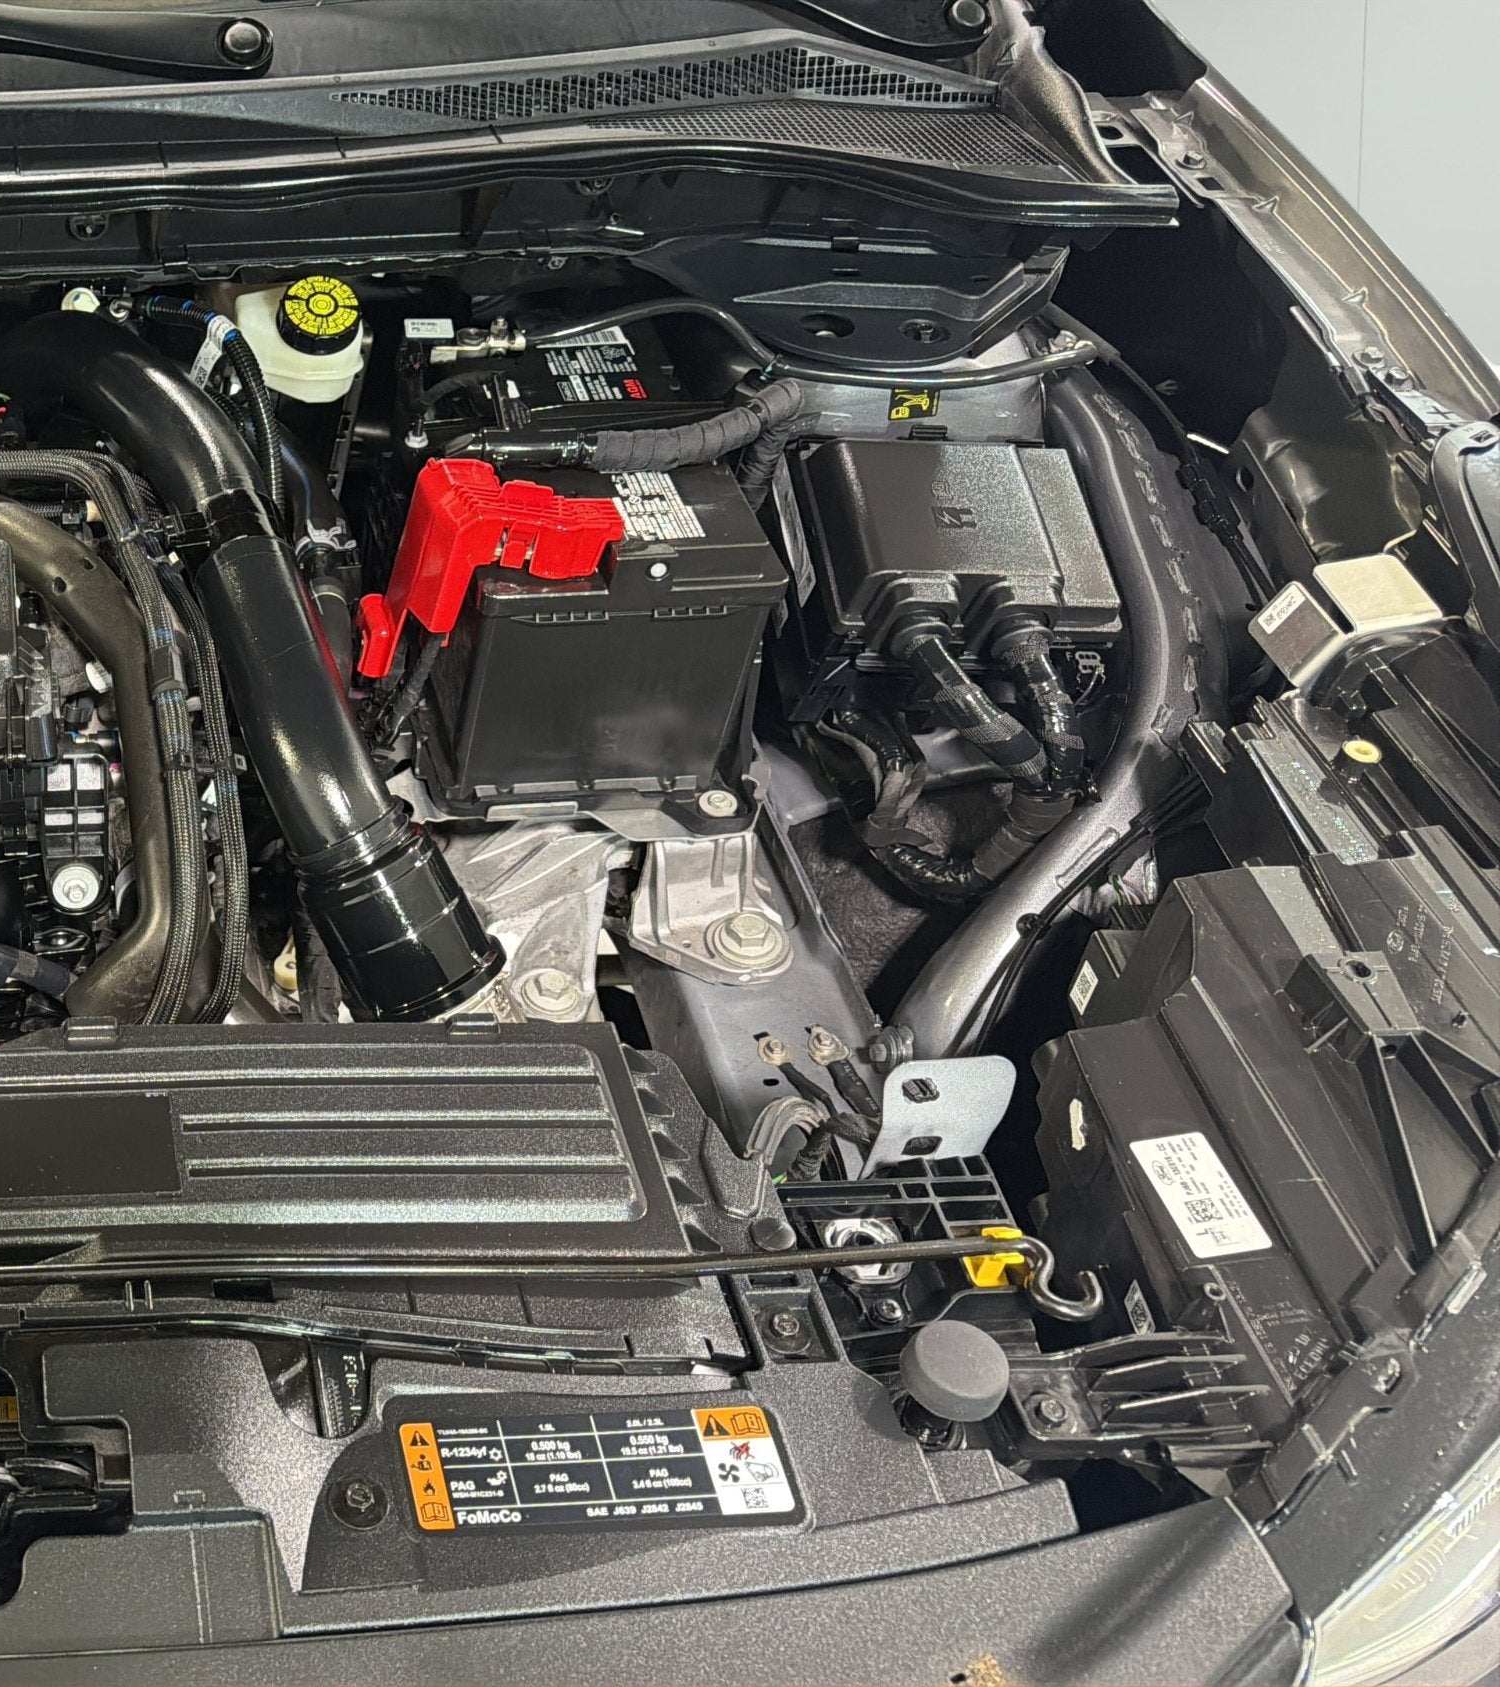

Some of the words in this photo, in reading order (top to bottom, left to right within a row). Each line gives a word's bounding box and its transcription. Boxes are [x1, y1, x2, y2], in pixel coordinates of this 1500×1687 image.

[623, 379, 642, 398] AGM
[1196, 1228, 1210, 1236] L
[538, 1423, 556, 1432] 1.5L
[531, 1440, 556, 1451] 0.500
[556, 1440, 570, 1452] kg
[630, 1436, 654, 1446] 0.550
[655, 1434, 669, 1446] kg
[440, 1446, 487, 1458] R-1234yf
[525, 1452, 536, 1461] 18
[566, 1450, 582, 1460] lbs)
[620, 1447, 638, 1456] 19.5
[649, 1446, 667, 1456] (1.21
[668, 1444, 684, 1454] lbs)
[550, 1474, 569, 1482] PAG
[650, 1468, 668, 1478] PAG
[450, 1480, 476, 1491] PAG
[534, 1485, 546, 1494] 2.7
[547, 1484, 554, 1492] fl
[566, 1483, 590, 1494] (80cc)
[632, 1480, 644, 1490] 3.4
[644, 1480, 652, 1488] fl
[663, 1478, 692, 1489] (100cc)
[586, 1508, 609, 1516] SAE
[613, 1506, 637, 1516] J639
[641, 1504, 670, 1514] J2842
[674, 1502, 704, 1512] J2845
[456, 1509, 522, 1524] FoMoCo
